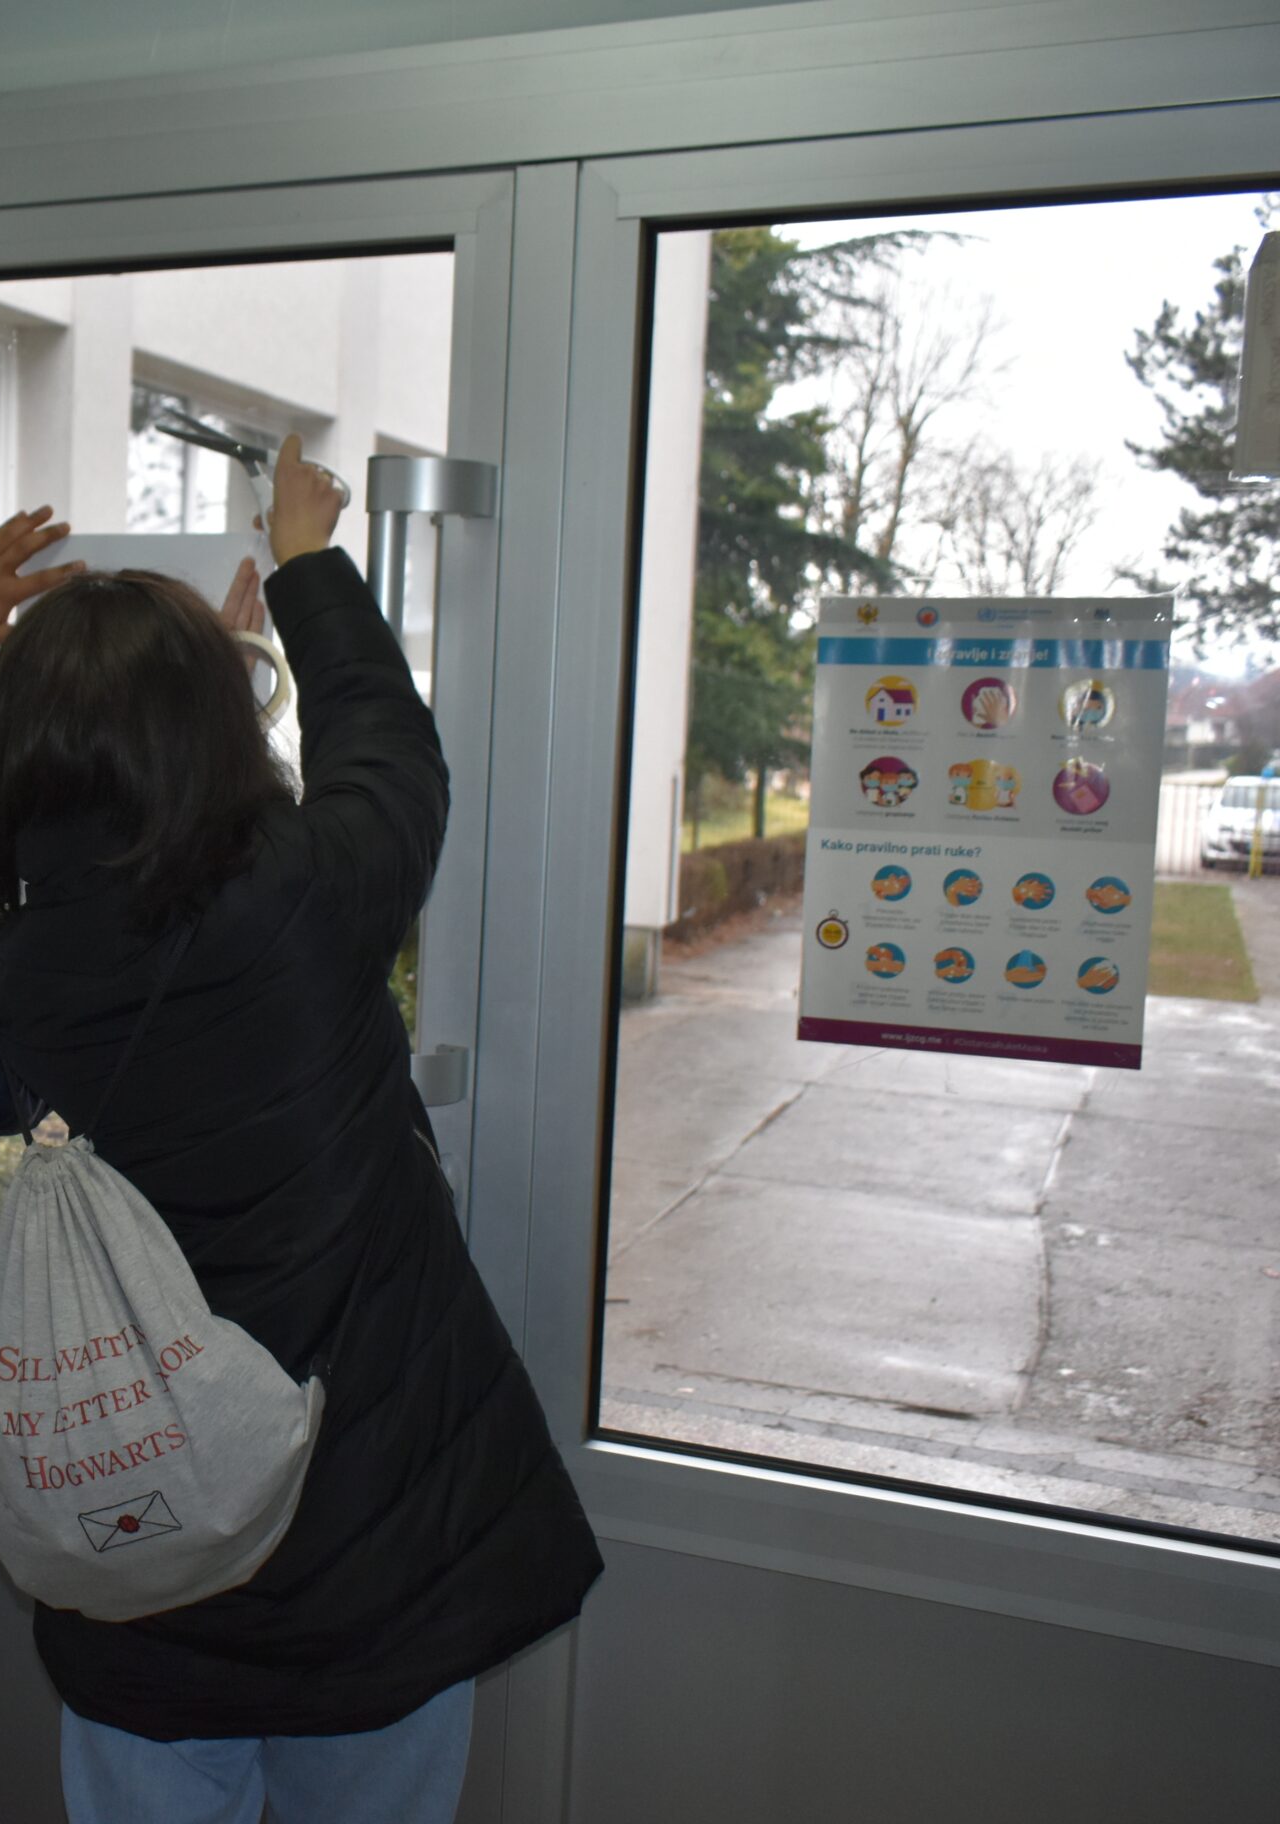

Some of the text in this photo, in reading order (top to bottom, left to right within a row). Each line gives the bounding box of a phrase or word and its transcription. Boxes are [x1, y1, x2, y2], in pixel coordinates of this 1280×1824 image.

[821, 838, 982, 861] Kako pravilno prati ruke?
[2, 1411, 45, 1437] MY
[21, 1422, 187, 1490] HOGWARTS
